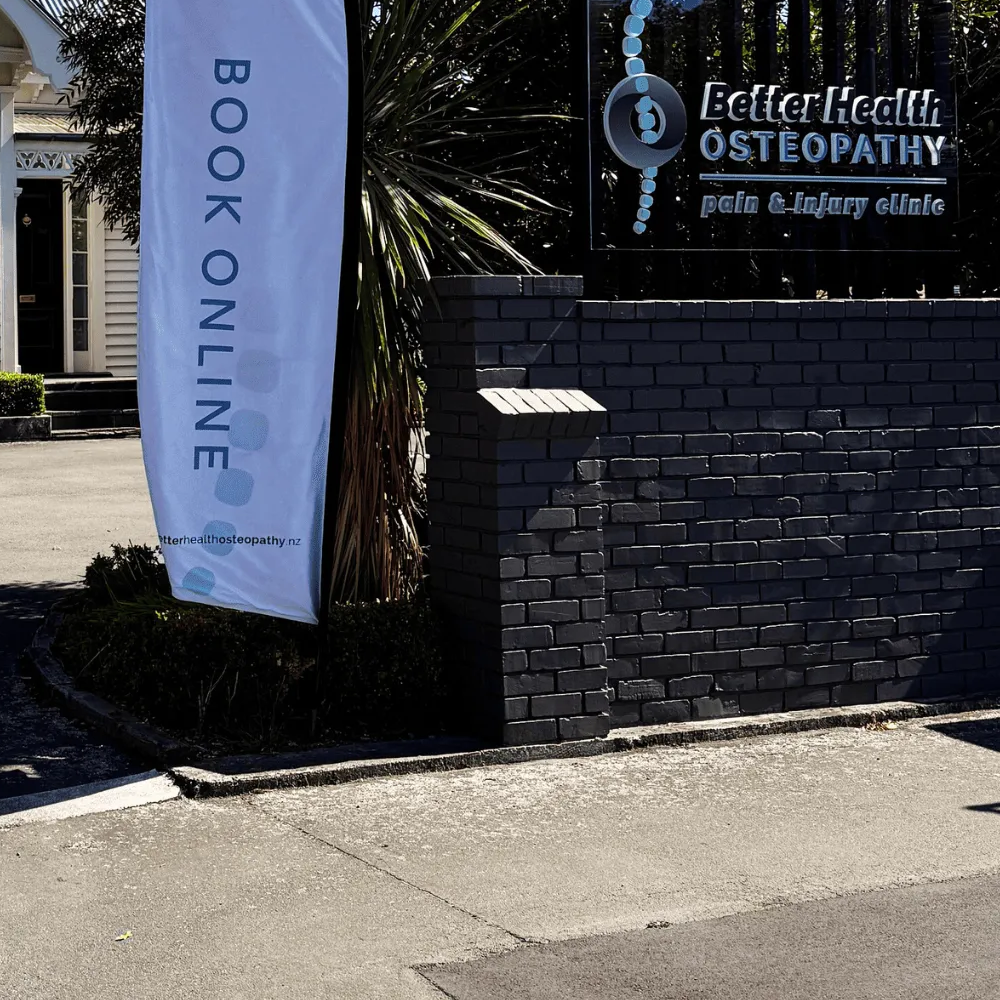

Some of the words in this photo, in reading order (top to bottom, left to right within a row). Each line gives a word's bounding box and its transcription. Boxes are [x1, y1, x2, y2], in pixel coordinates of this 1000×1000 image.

[701, 82, 822, 123] Better
[823, 86, 946, 127] Health
[204, 58, 251, 224] BOOK
[700, 129, 947, 166] OSTEOPATHY
[700, 191, 760, 218] pain
[768, 192, 786, 214] &
[793, 192, 868, 220] injury
[875, 194, 945, 216] clinic
[193, 249, 239, 470] ONLINE
